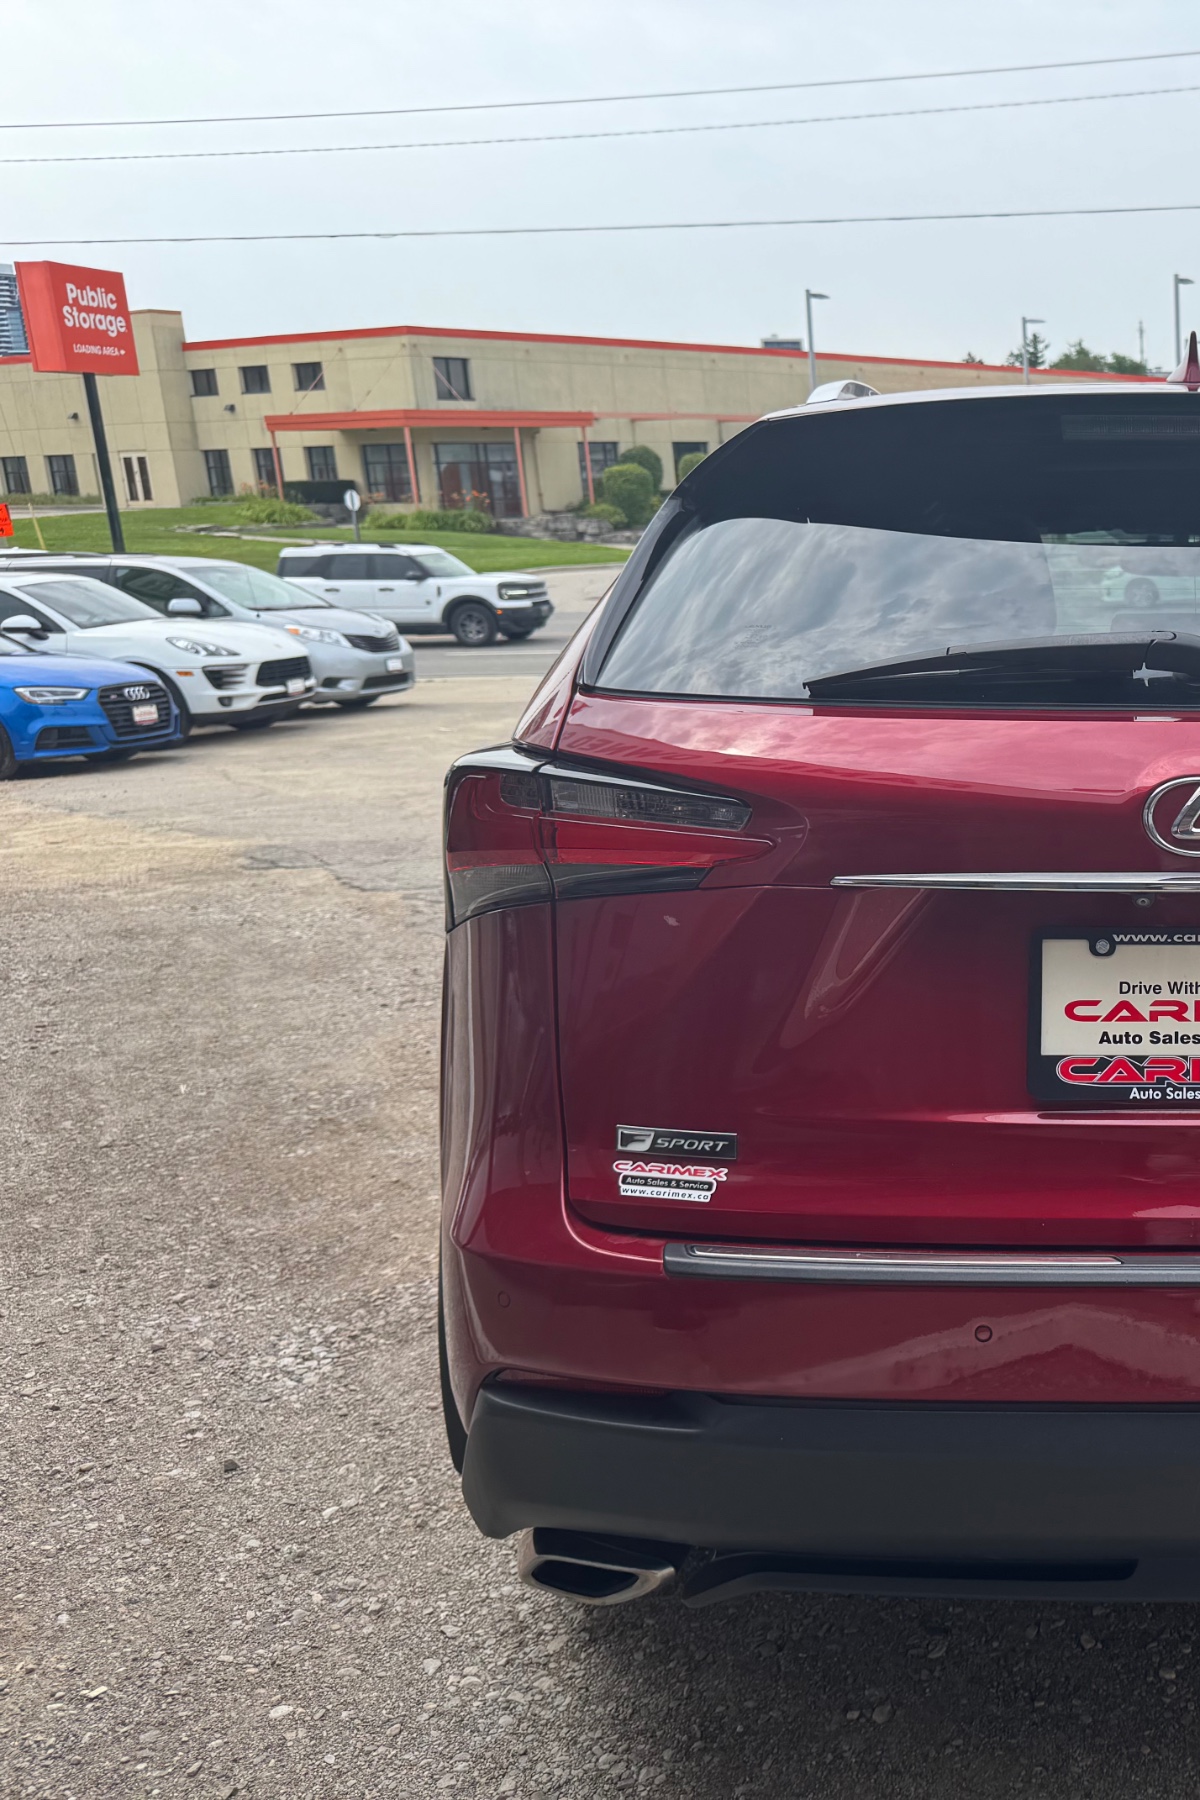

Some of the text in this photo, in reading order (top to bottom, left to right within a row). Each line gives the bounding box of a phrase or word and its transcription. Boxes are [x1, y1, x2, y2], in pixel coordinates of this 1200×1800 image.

[65, 283, 118, 310] Public
[62, 305, 126, 337] Storage
[73, 343, 119, 356] LOADING AREA
[1118, 981, 1162, 996] Drive
[1098, 1031, 1143, 1045] Auto
[1129, 1087, 1162, 1100] Auto
[654, 1137, 729, 1152] SPORT
[614, 1161, 727, 1180] CARIMEX
[625, 1176, 645, 1185] Auto
[647, 1178, 669, 1187] Sales
[679, 1181, 709, 1190] Service
[621, 1187, 709, 1201] www.carimex.ca
